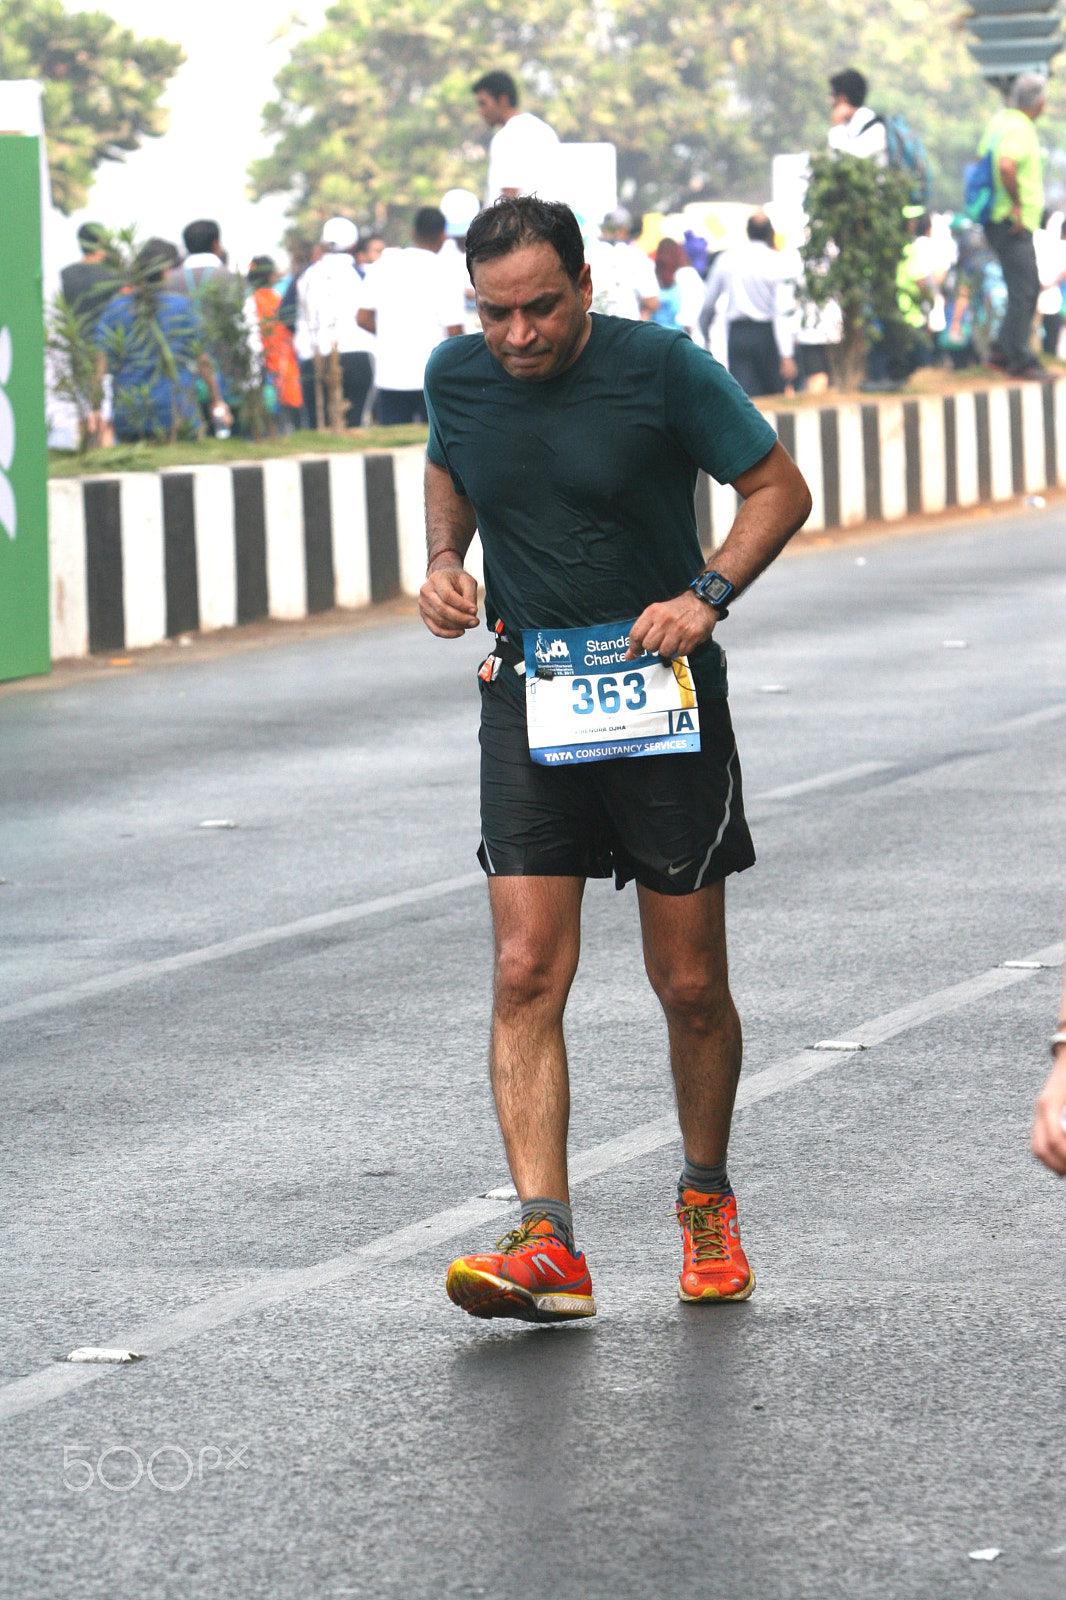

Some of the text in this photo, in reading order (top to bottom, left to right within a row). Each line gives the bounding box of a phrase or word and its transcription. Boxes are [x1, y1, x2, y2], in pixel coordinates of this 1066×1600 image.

[586, 635, 630, 652] Standa
[571, 672, 647, 715] 363
[608, 724, 626, 732] OJHA
[675, 711, 695, 732] A
[544, 739, 687, 762] TATA CONSULTANCY SERVICES
